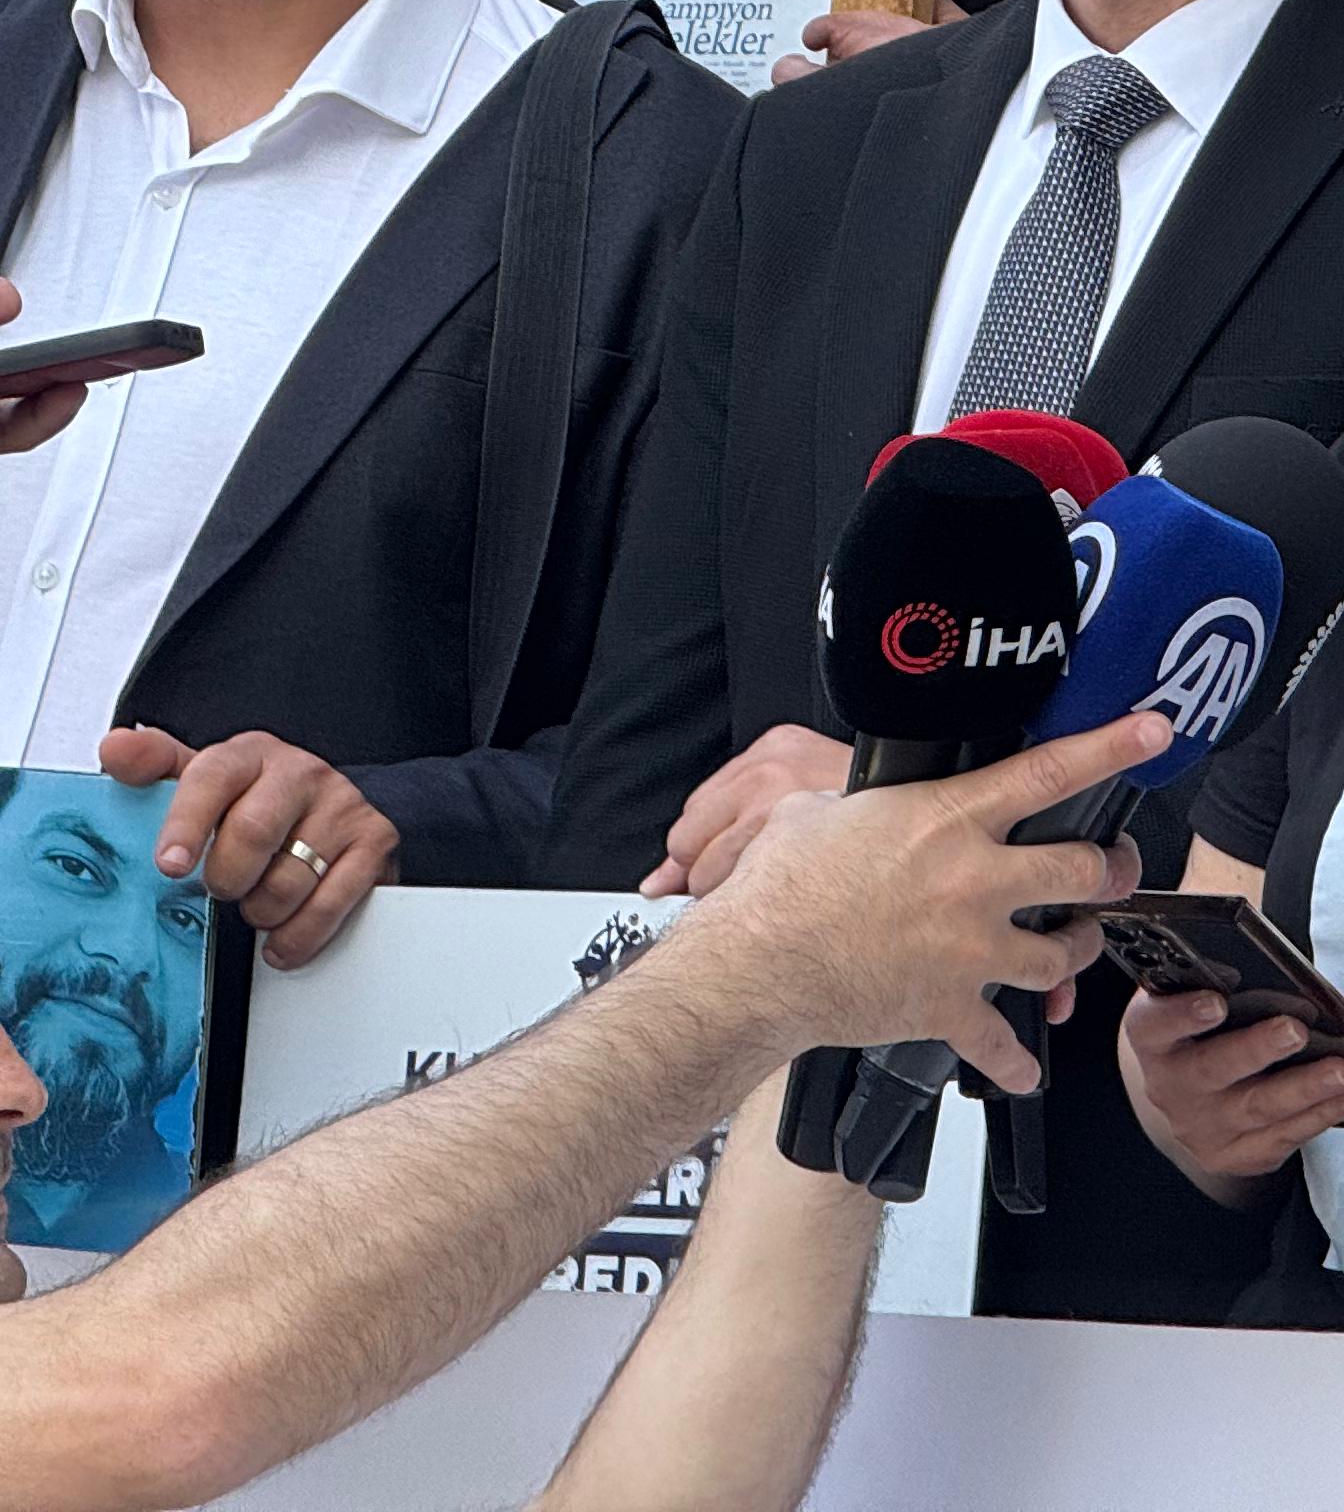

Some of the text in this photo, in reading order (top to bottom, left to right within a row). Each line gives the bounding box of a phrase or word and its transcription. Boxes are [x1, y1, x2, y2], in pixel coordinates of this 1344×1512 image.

[673, 19, 775, 55] elekler
[964, 616, 1069, 676] İHA
[1131, 632, 1249, 743] AA
